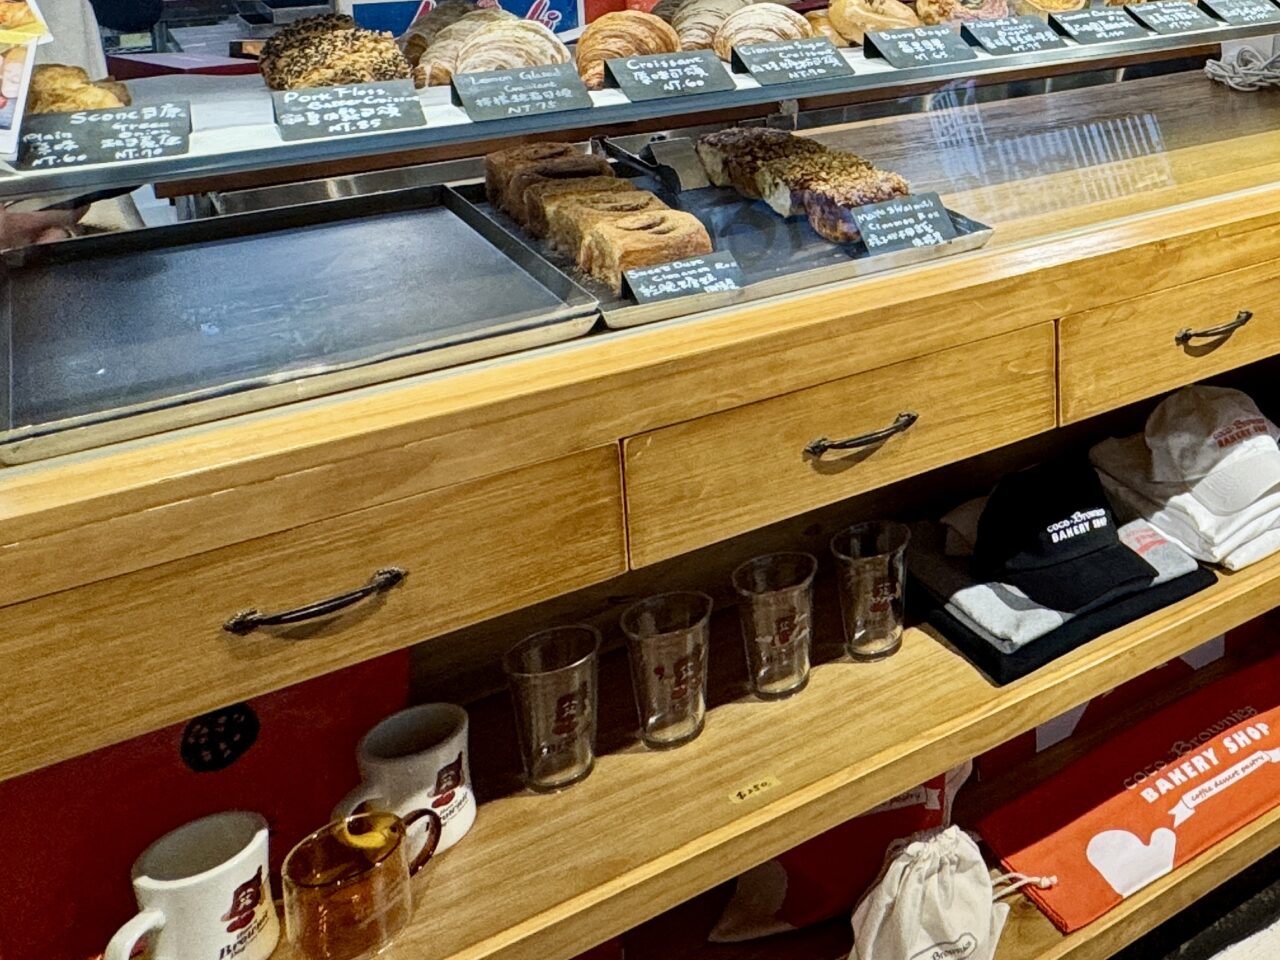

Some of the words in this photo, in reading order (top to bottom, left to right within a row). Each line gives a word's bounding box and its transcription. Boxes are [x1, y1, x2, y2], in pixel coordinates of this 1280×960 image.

[284, 91, 333, 103] Pork
[70, 111, 138, 125] Scone
[1051, 520, 1091, 544] BAKERY
[1139, 746, 1220, 804] BAKERY
[1222, 721, 1270, 755] SHOP
